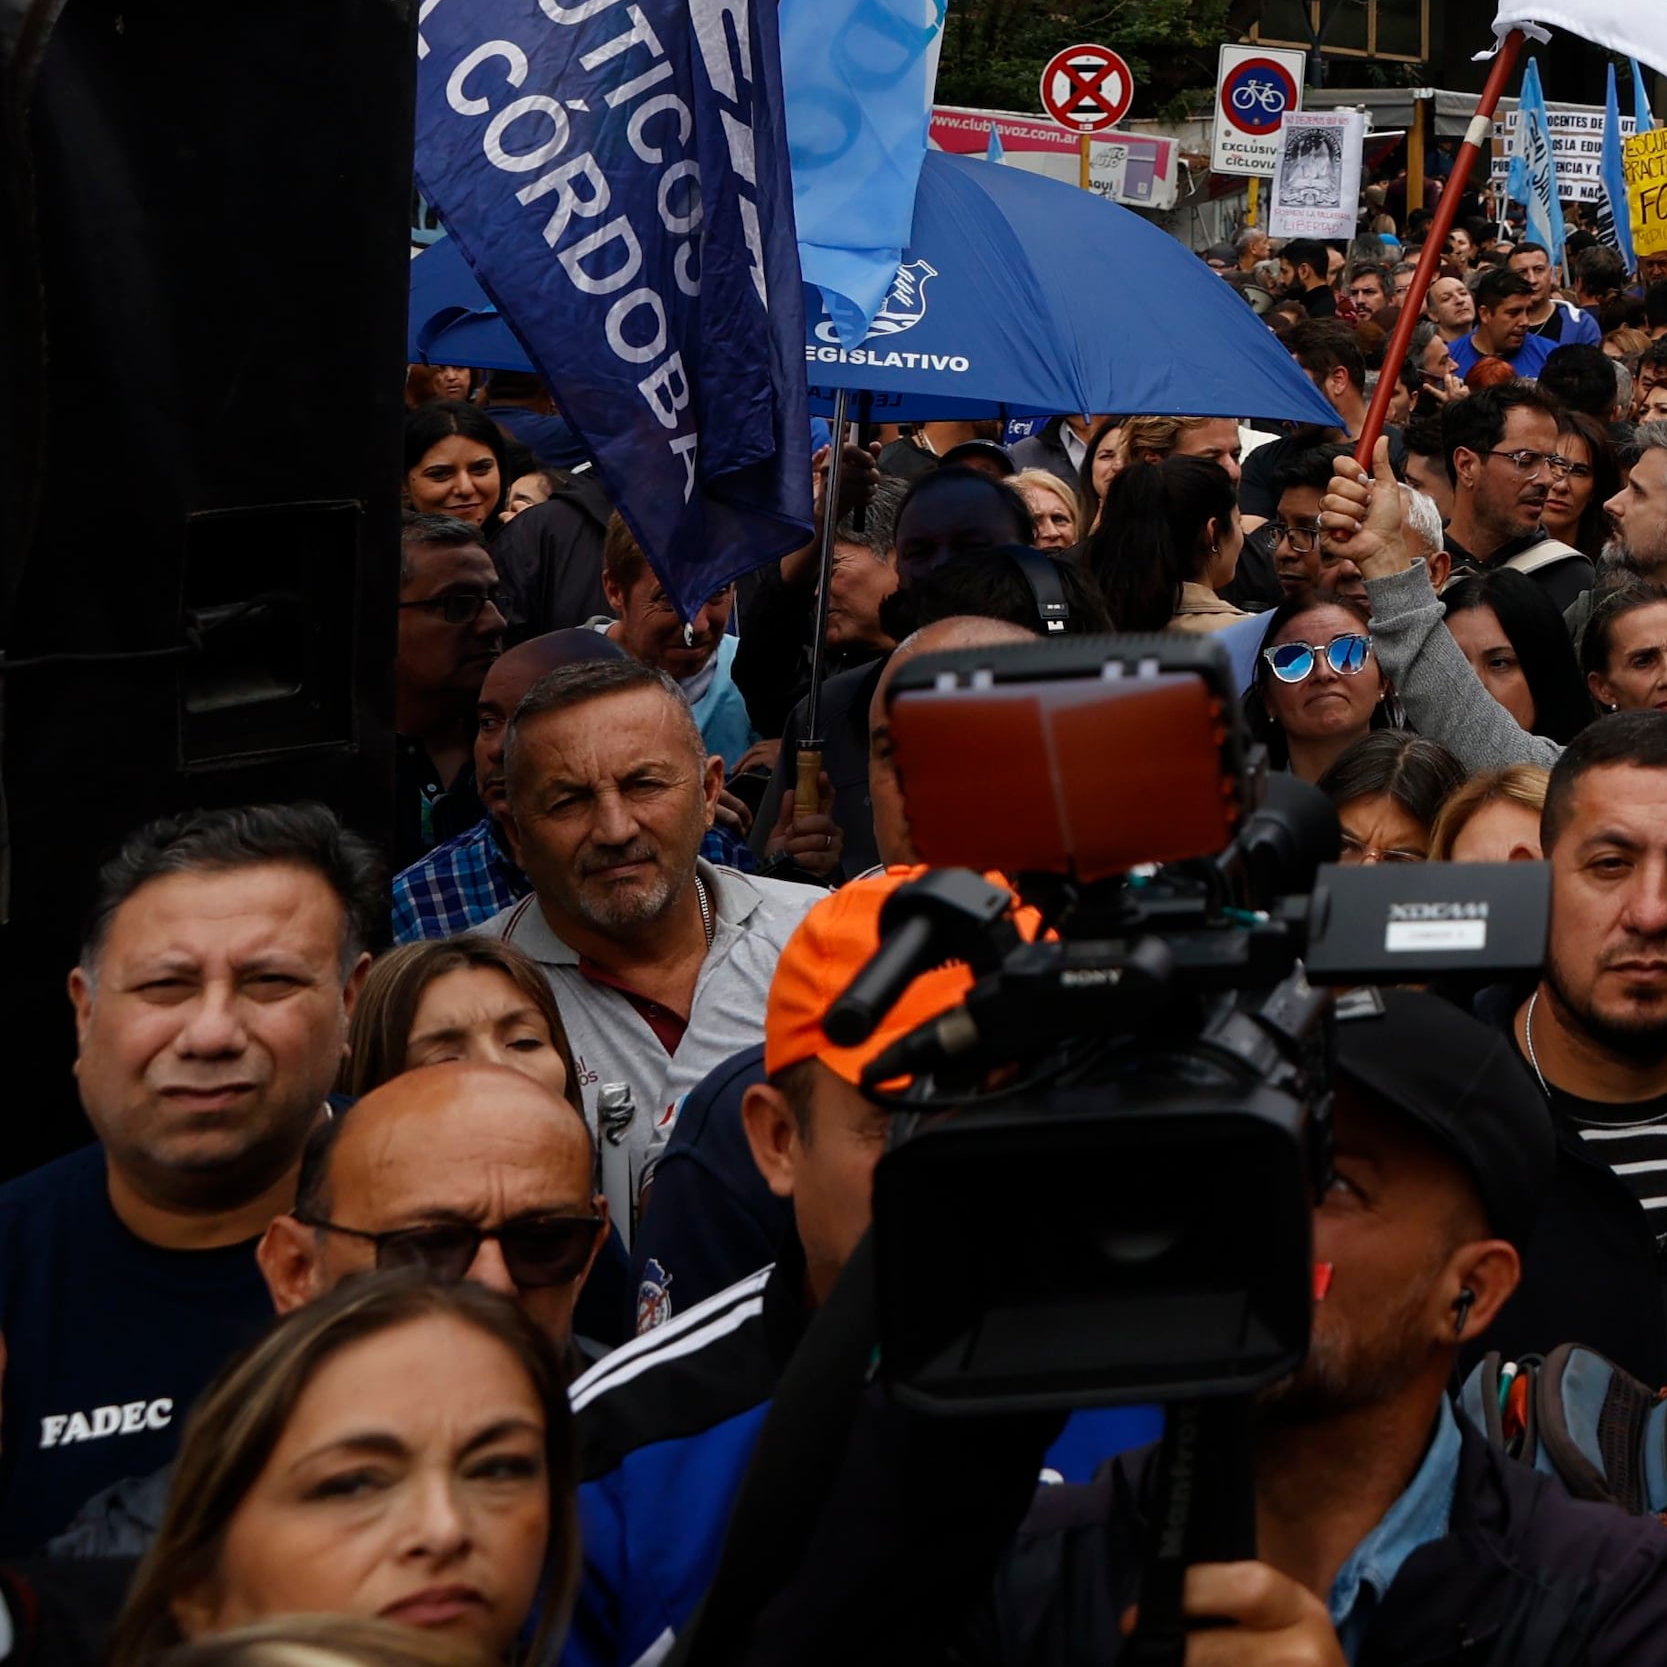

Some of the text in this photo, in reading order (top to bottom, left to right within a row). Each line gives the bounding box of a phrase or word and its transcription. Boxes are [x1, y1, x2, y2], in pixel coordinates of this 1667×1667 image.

[1565, 139, 1576, 151] LA
[1585, 164, 1592, 174] Y
[1061, 969, 1122, 986] SONY
[39, 1397, 174, 1449] FADEC
